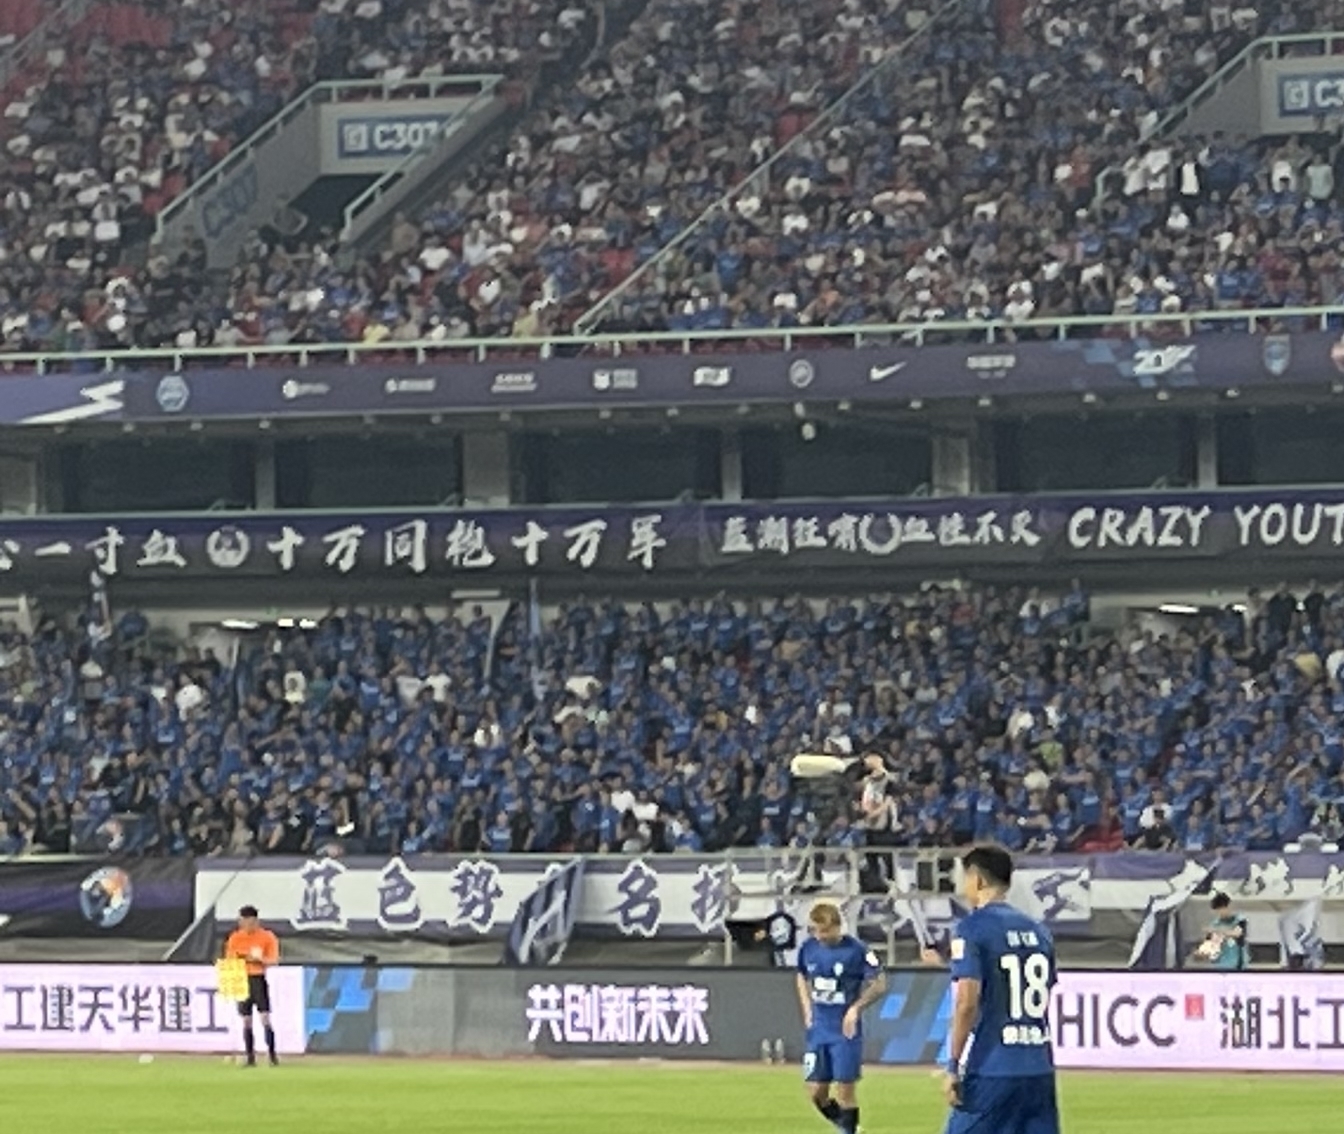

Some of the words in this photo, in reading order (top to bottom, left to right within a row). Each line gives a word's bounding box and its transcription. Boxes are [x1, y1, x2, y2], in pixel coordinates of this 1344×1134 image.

[1067, 505, 1210, 549] CRAZY
[526, 984, 710, 1042] 共创新未来
[1000, 952, 1050, 1019] 18
[1056, 993, 1176, 1049] HICC
